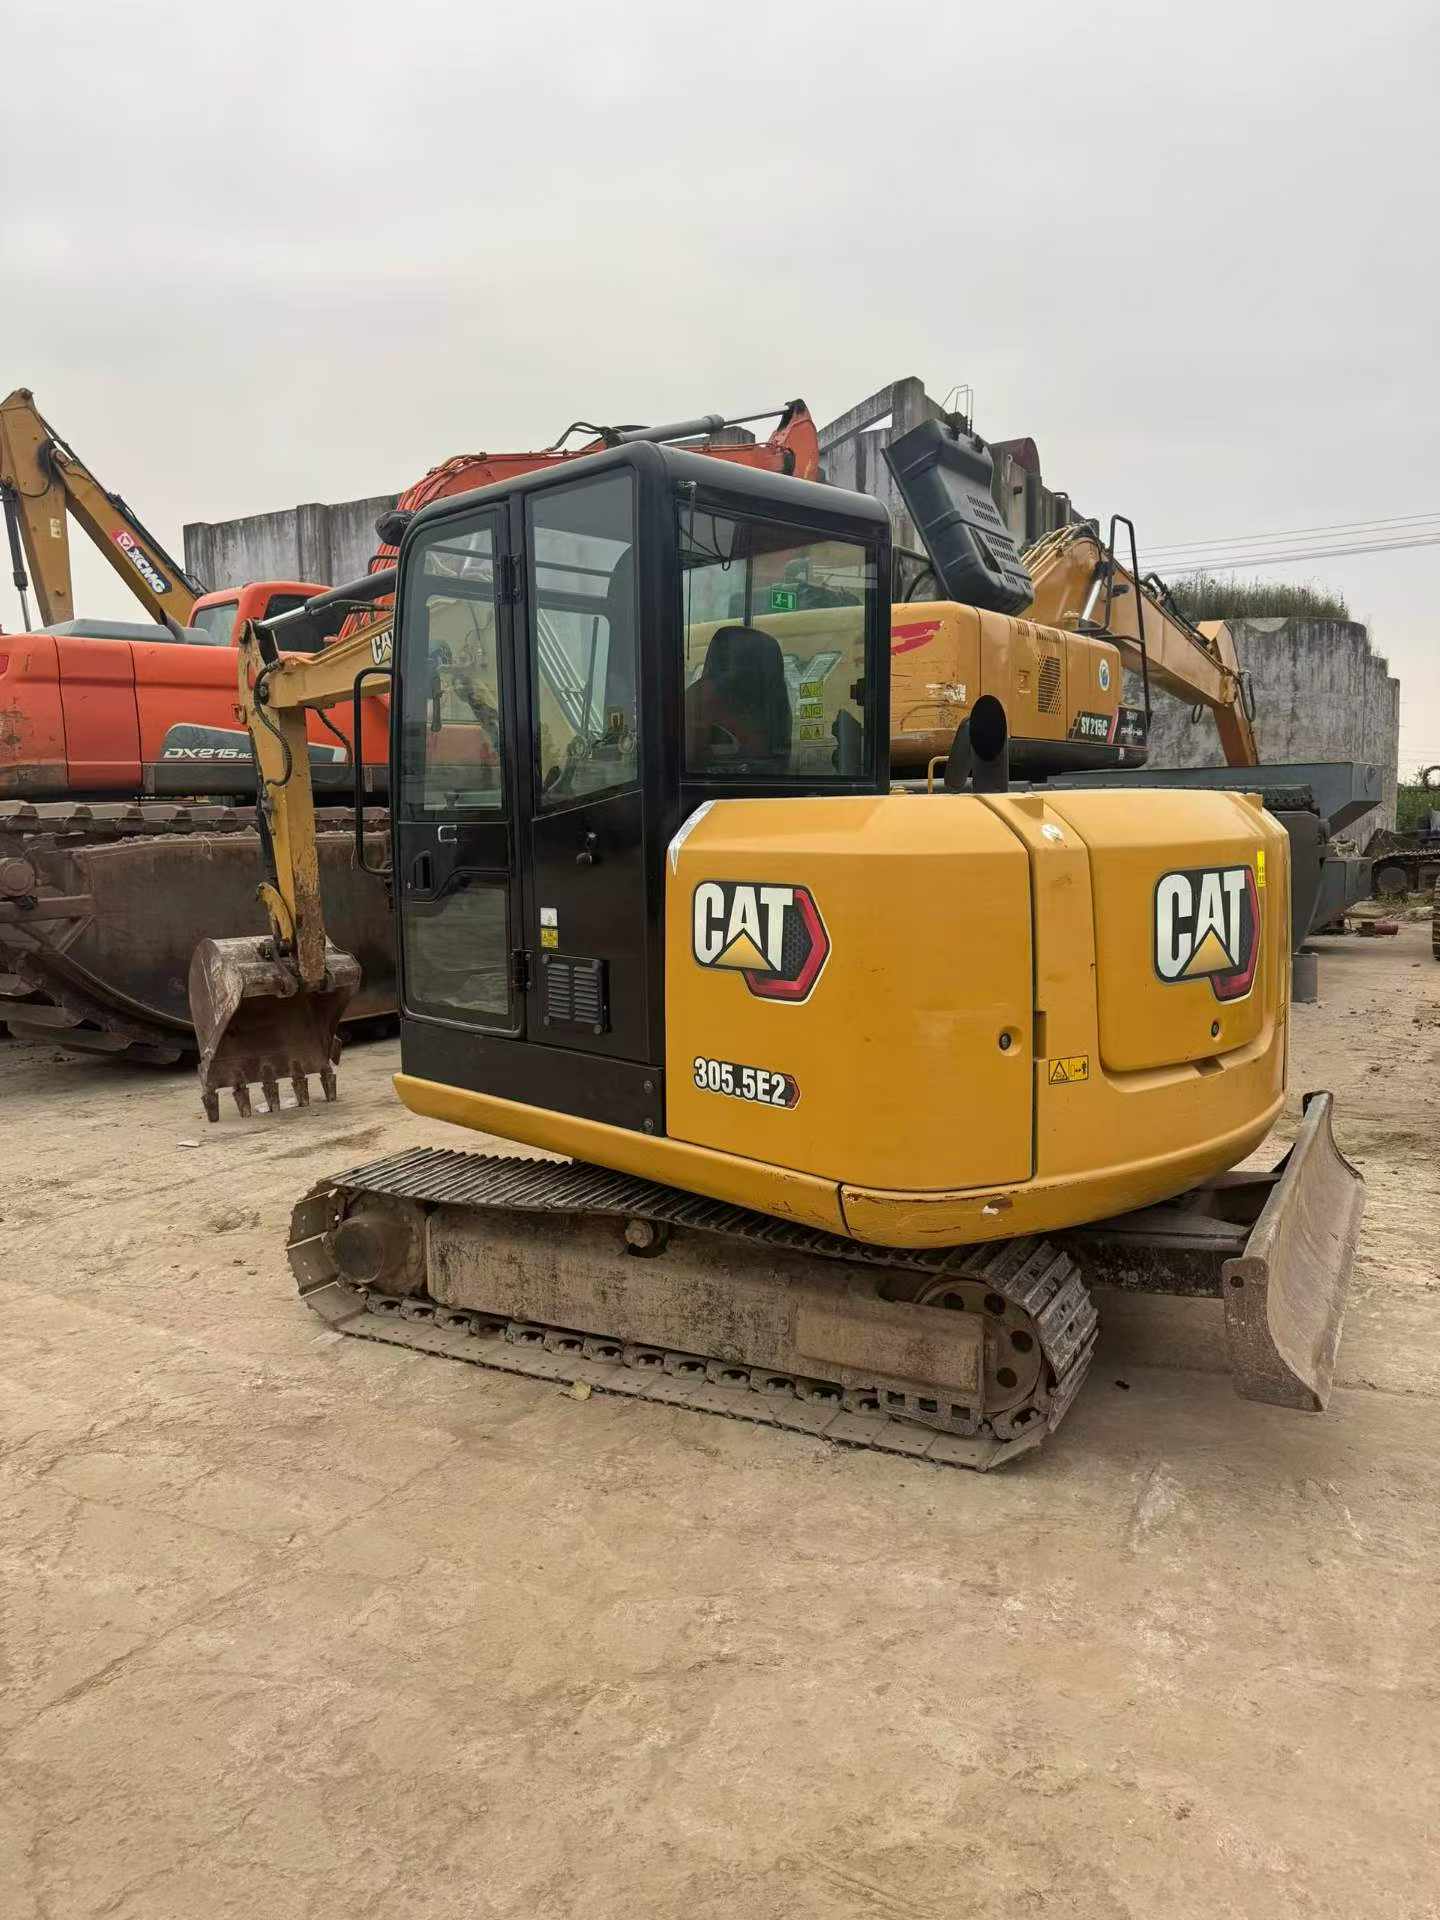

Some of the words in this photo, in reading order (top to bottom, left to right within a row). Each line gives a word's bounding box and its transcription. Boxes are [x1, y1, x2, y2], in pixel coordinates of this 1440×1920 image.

[127, 547, 166, 593] XCMG
[695, 883, 793, 971] CAT
[1157, 870, 1245, 978] CAT
[695, 1057, 786, 1105] 305.5E2
